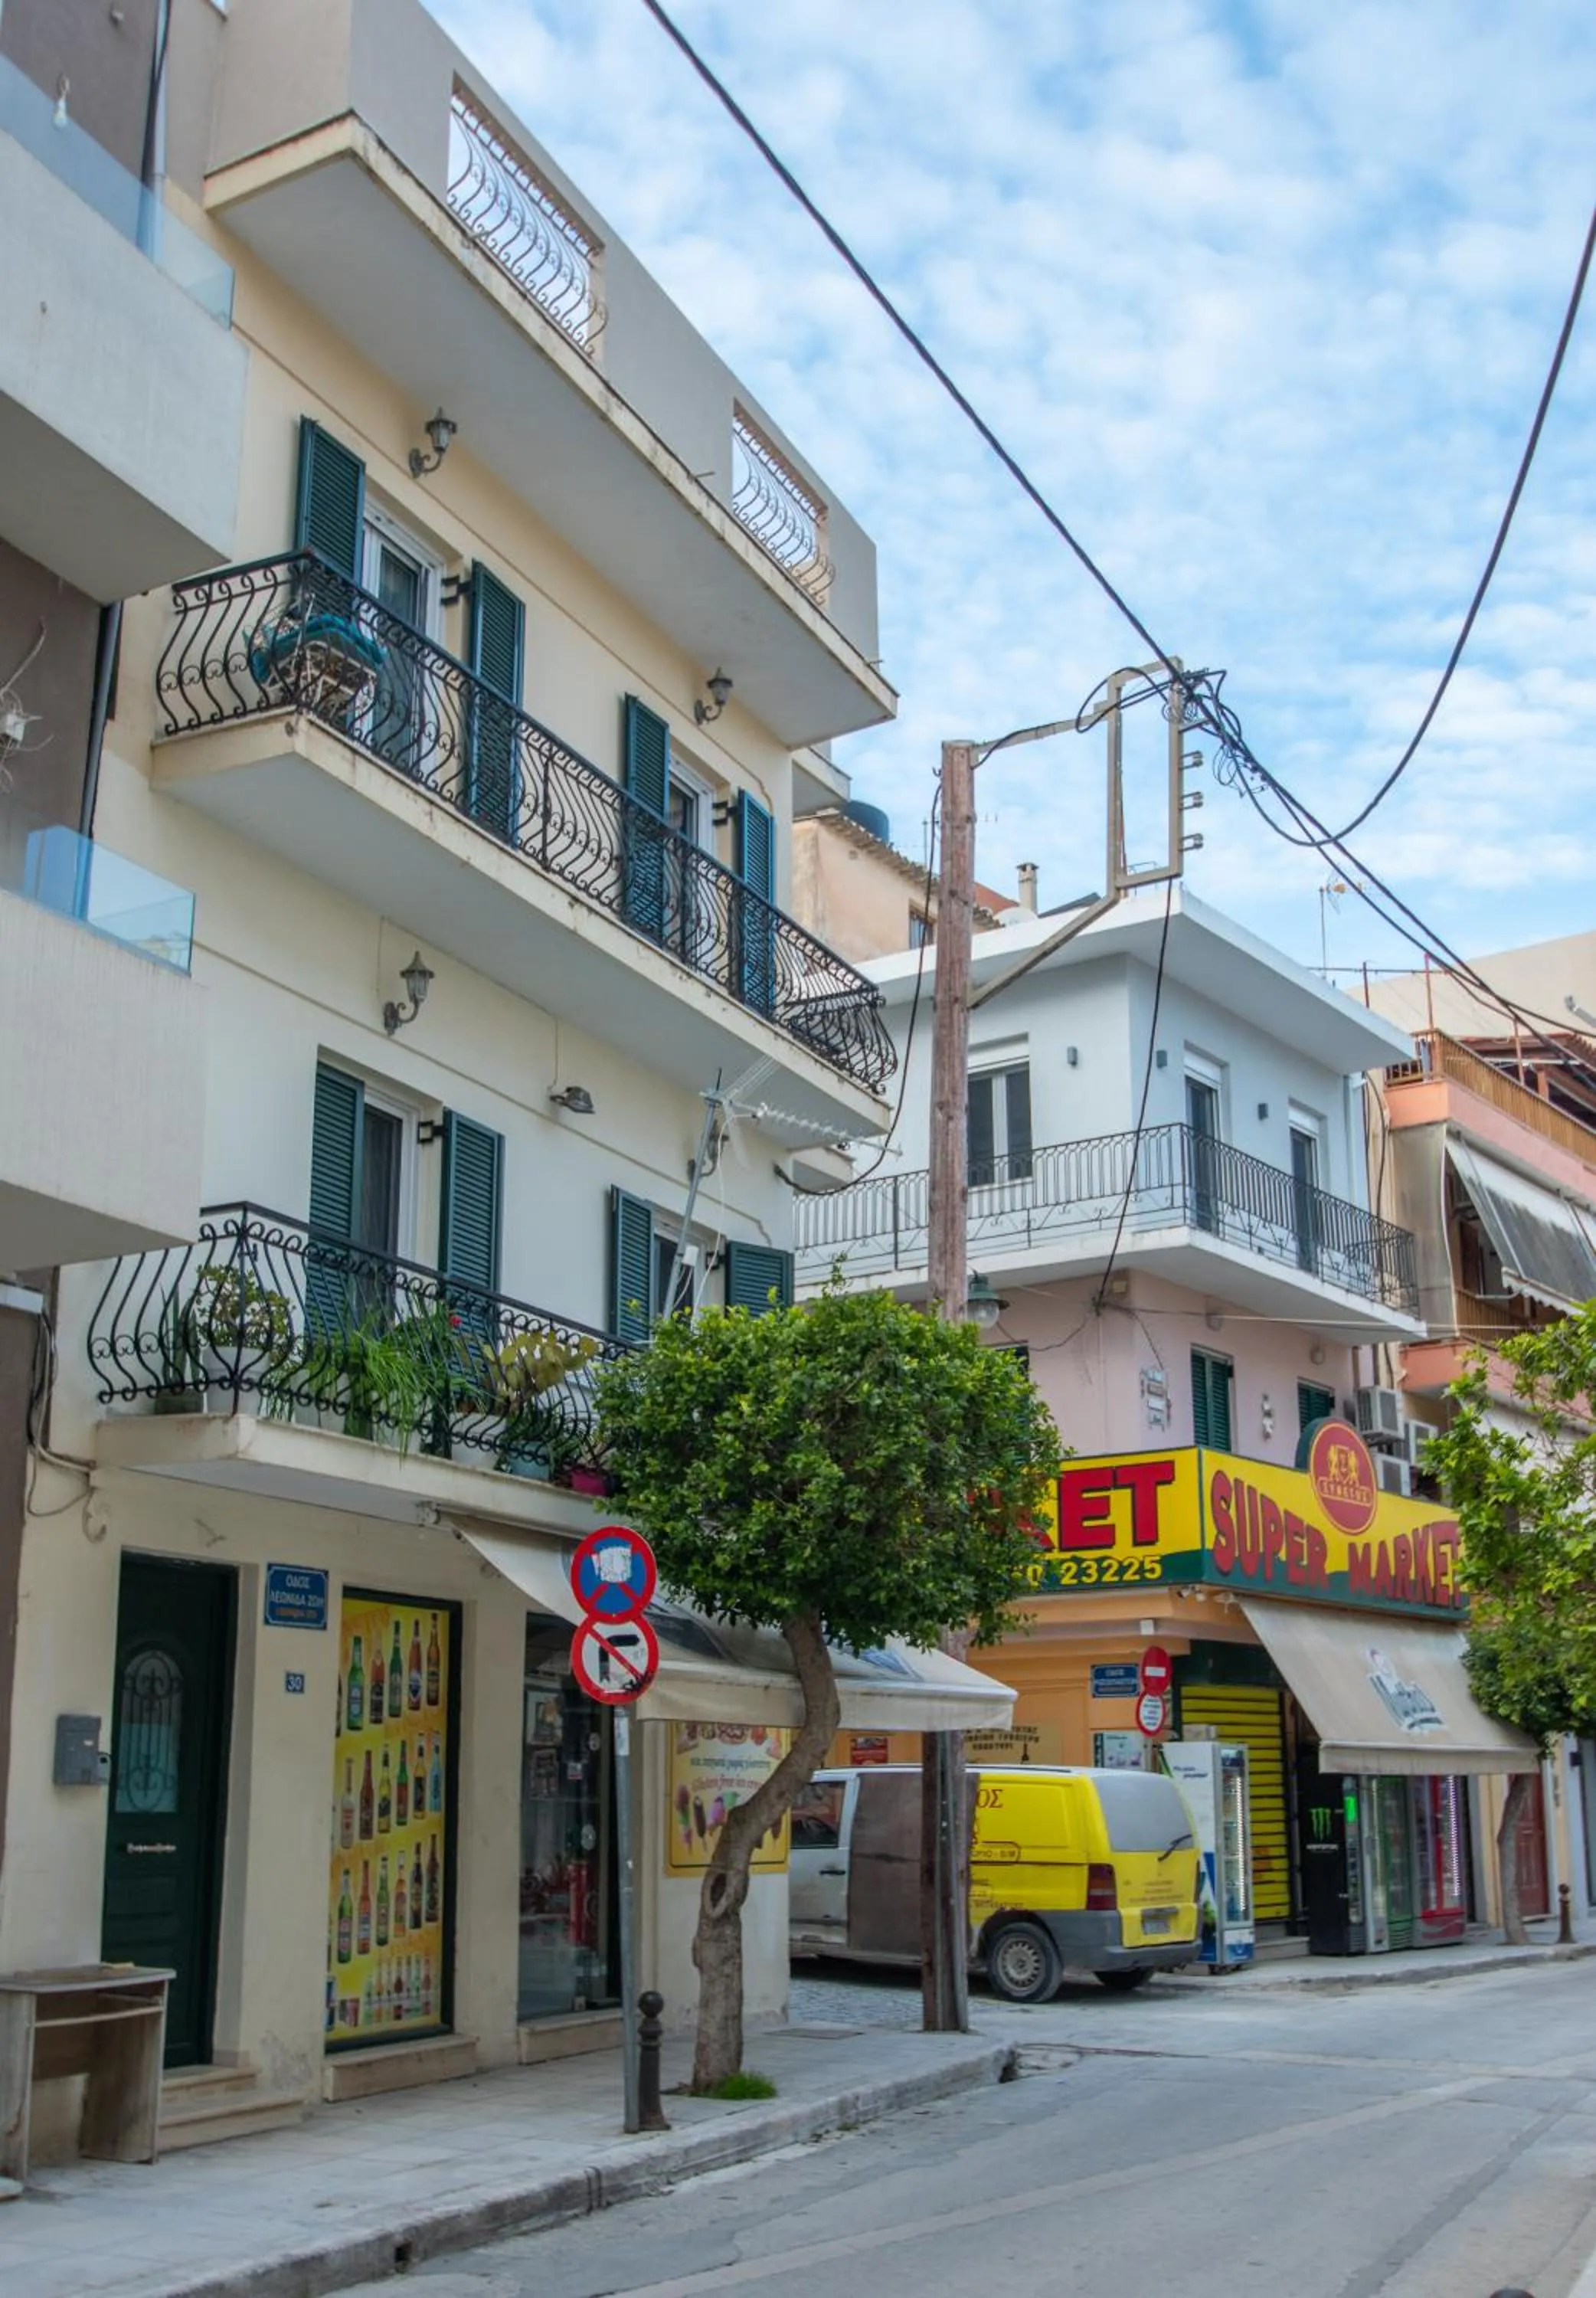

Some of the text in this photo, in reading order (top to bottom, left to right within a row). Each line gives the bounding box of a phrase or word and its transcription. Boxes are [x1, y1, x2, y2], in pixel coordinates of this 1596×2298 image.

[1211, 1469, 1463, 1608] SUPER MARKET
[1060, 1556, 1163, 1586] 23225
[287, 1676, 303, 1691] 30
